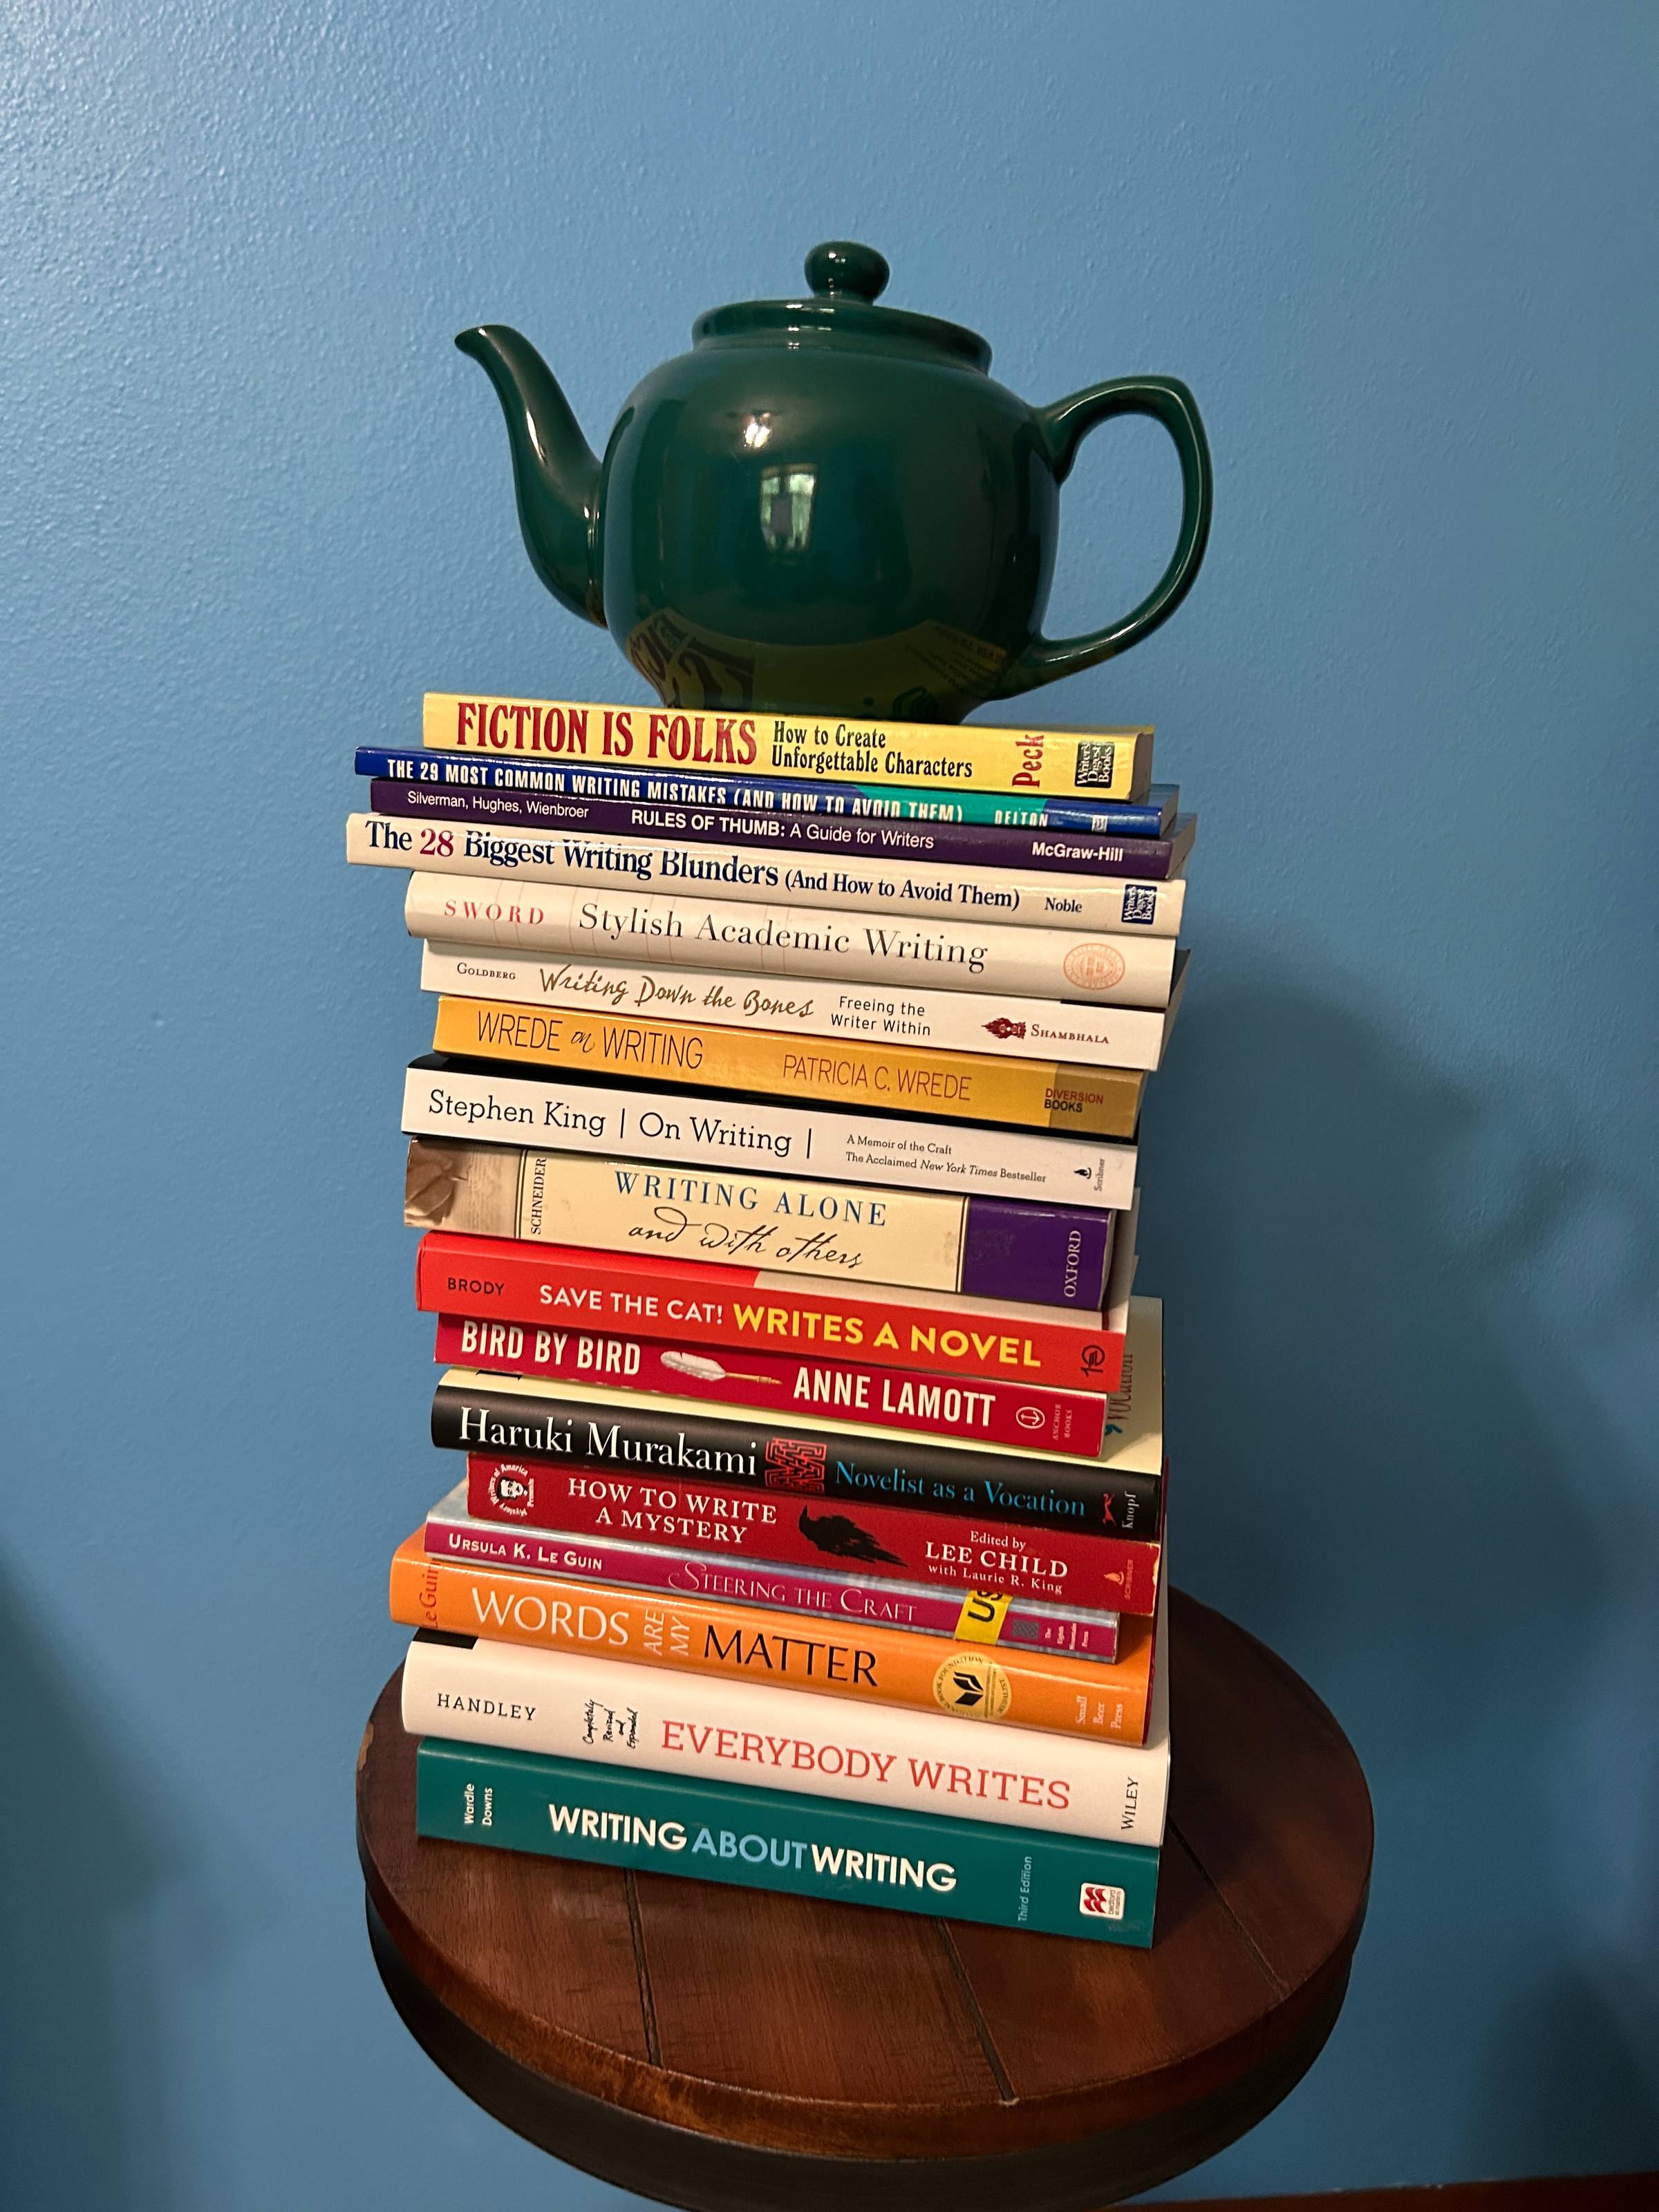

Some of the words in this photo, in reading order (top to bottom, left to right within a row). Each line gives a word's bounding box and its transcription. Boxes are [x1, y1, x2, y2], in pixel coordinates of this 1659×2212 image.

[456, 702, 588, 754] FICTION
[602, 711, 634, 757] IS
[648, 714, 758, 765] FOLKS
[774, 721, 807, 744] How
[814, 725, 829, 745] to
[835, 724, 885, 748] Create
[771, 744, 878, 774] Unforgettable
[885, 751, 973, 778] Characters
[1012, 734, 1044, 787] Peck
[1098, 747, 1112, 782] Books
[388, 759, 413, 778] THE
[420, 762, 439, 780] 29
[446, 764, 488, 785] MOST
[495, 769, 565, 791] COMMON
[572, 775, 640, 798] WRITING
[648, 781, 727, 805] MISTAKES
[733, 789, 774, 809] (AND
[781, 793, 818, 812] HOW
[825, 796, 844, 814] TO
[852, 798, 900, 818] AVOID
[909, 802, 962, 823] THEM)
[408, 790, 468, 810] Silverman,
[473, 796, 522, 814] Hughes,
[526, 800, 589, 818] Wienbroer
[632, 809, 686, 829] RULES
[691, 815, 713, 831] OF
[719, 817, 785, 838] THUMB:
[790, 823, 801, 838] A
[807, 823, 852, 843] Guide
[856, 830, 877, 844] for
[881, 832, 934, 850] Writers
[365, 821, 412, 851] The
[420, 828, 454, 856] 28
[464, 830, 554, 867] Biggest
[562, 839, 653, 881] Writing
[659, 850, 779, 886] Blunders
[785, 869, 827, 891] (And
[832, 873, 873, 894] How
[879, 879, 894, 897] to
[900, 879, 953, 903] Avoid
[957, 884, 1020, 911] Them)
[1032, 841, 1124, 862] McGraw-Hill
[444, 899, 545, 925] SWORD
[1044, 897, 1082, 912] Noble
[579, 903, 683, 940] Stylish
[694, 914, 850, 953] Academic
[863, 927, 988, 974] Writing
[456, 962, 516, 980] GOLDBERG
[539, 964, 630, 1006] Writing
[635, 975, 697, 1006] Down
[702, 985, 736, 1008] the
[743, 989, 814, 1018] Bones
[831, 1013, 877, 1030] Writer
[883, 1019, 930, 1036] Within
[839, 995, 894, 1016] Freeing
[901, 1002, 925, 1017] the
[478, 1010, 563, 1051] WREDE
[570, 1029, 596, 1053] on
[603, 1026, 703, 1069] WRITING
[1031, 1024, 1109, 1044] SHAMBHALA
[783, 1053, 868, 1088] PATRICIA
[874, 1066, 890, 1091] C.
[898, 1068, 972, 1100] WREDE
[1045, 1087, 1104, 1105] DIVERSION
[429, 1089, 534, 1123] Stephen
[544, 1101, 606, 1137] King
[1044, 1099, 1083, 1113] BOOKS
[639, 1112, 681, 1139] On
[690, 1116, 792, 1158] Writing
[847, 1134, 856, 1145] A
[857, 1136, 895, 1150] Memoir
[897, 1140, 908, 1151] of
[910, 1141, 925, 1153] the
[927, 1143, 952, 1155] Craft
[846, 1152, 863, 1163] The
[866, 1153, 917, 1169] Acclaimed
[920, 1160, 944, 1171] New
[946, 1162, 966, 1174] York
[969, 1164, 998, 1178] Times
[1000, 1168, 1047, 1183] Bestseller
[1094, 1158, 1106, 1191] Scribner
[531, 1158, 547, 1235] SCHNEIDER
[615, 1170, 758, 1210] WRITING
[774, 1191, 887, 1226] ALONE
[628, 1206, 702, 1242] and
[699, 1223, 779, 1255] with
[776, 1232, 863, 1268] others
[1064, 1230, 1082, 1298] OXFORD
[448, 1277, 505, 1296] BRODY
[539, 1284, 603, 1311] SAVE
[610, 1293, 659, 1317] THE
[667, 1300, 723, 1324] CAT!
[733, 1303, 863, 1344] WRITES
[873, 1322, 899, 1349] A
[911, 1324, 1041, 1367] NOVEL
[461, 1320, 524, 1359] BIRD
[534, 1329, 568, 1365] BY
[577, 1335, 641, 1375] BIRD
[793, 1366, 871, 1409] ANNE
[882, 1379, 995, 1427] LAMOTT
[459, 1406, 573, 1452] Haruki
[585, 1422, 757, 1476] Murakami
[1052, 1404, 1062, 1441] ANCHOR
[1064, 1409, 1073, 1438] BOOKS
[568, 1478, 632, 1503] HOW
[639, 1487, 677, 1510] TO
[686, 1494, 777, 1525] WRITE
[835, 1460, 925, 1496] Novelist
[932, 1483, 955, 1499] as
[964, 1487, 975, 1502] a
[984, 1480, 1085, 1517] Vocation
[595, 1506, 613, 1525] A
[621, 1510, 747, 1544] MYSTERY
[1122, 1490, 1139, 1530] Knopf
[449, 1533, 506, 1556] URSULA
[514, 1543, 530, 1560] K.
[563, 1553, 602, 1571] GUIN
[926, 1541, 973, 1564] LEE
[980, 1550, 1068, 1577] CHILD
[971, 1530, 1008, 1548] Edited
[1012, 1537, 1026, 1553] by
[668, 1561, 785, 1602] STEERING
[794, 1587, 832, 1607] THE
[840, 1588, 917, 1622] CRAFT
[928, 1564, 957, 1577] with
[963, 1567, 1005, 1584] Laurie
[1011, 1574, 1024, 1586] R.
[1031, 1579, 1062, 1595] King
[472, 1587, 630, 1647] WORDS
[643, 1609, 664, 1657] ARE
[671, 1615, 691, 1657] MY
[704, 1624, 879, 1687] MATTER
[438, 1693, 536, 1721] HANDLEY
[582, 1698, 603, 1745] Completely
[603, 1708, 616, 1742] Revised
[1076, 1695, 1087, 1725] Small
[1093, 1702, 1105, 1725] Beer
[1110, 1703, 1123, 1730] Press
[618, 1720, 626, 1735] and
[626, 1707, 639, 1749] Expanded
[661, 1721, 897, 1782] EVERYBODY
[908, 1757, 1071, 1810] WRITES
[464, 1783, 475, 1825] Wardle
[482, 1787, 493, 1827] Downs
[1121, 1776, 1138, 1830] WILEY
[549, 1803, 687, 1850] WRITING
[691, 1828, 807, 1869] ABOUT
[812, 1844, 957, 1891] WRITING
[1020, 1856, 1032, 1893] Edition
[1018, 1895, 1029, 1922] Third
